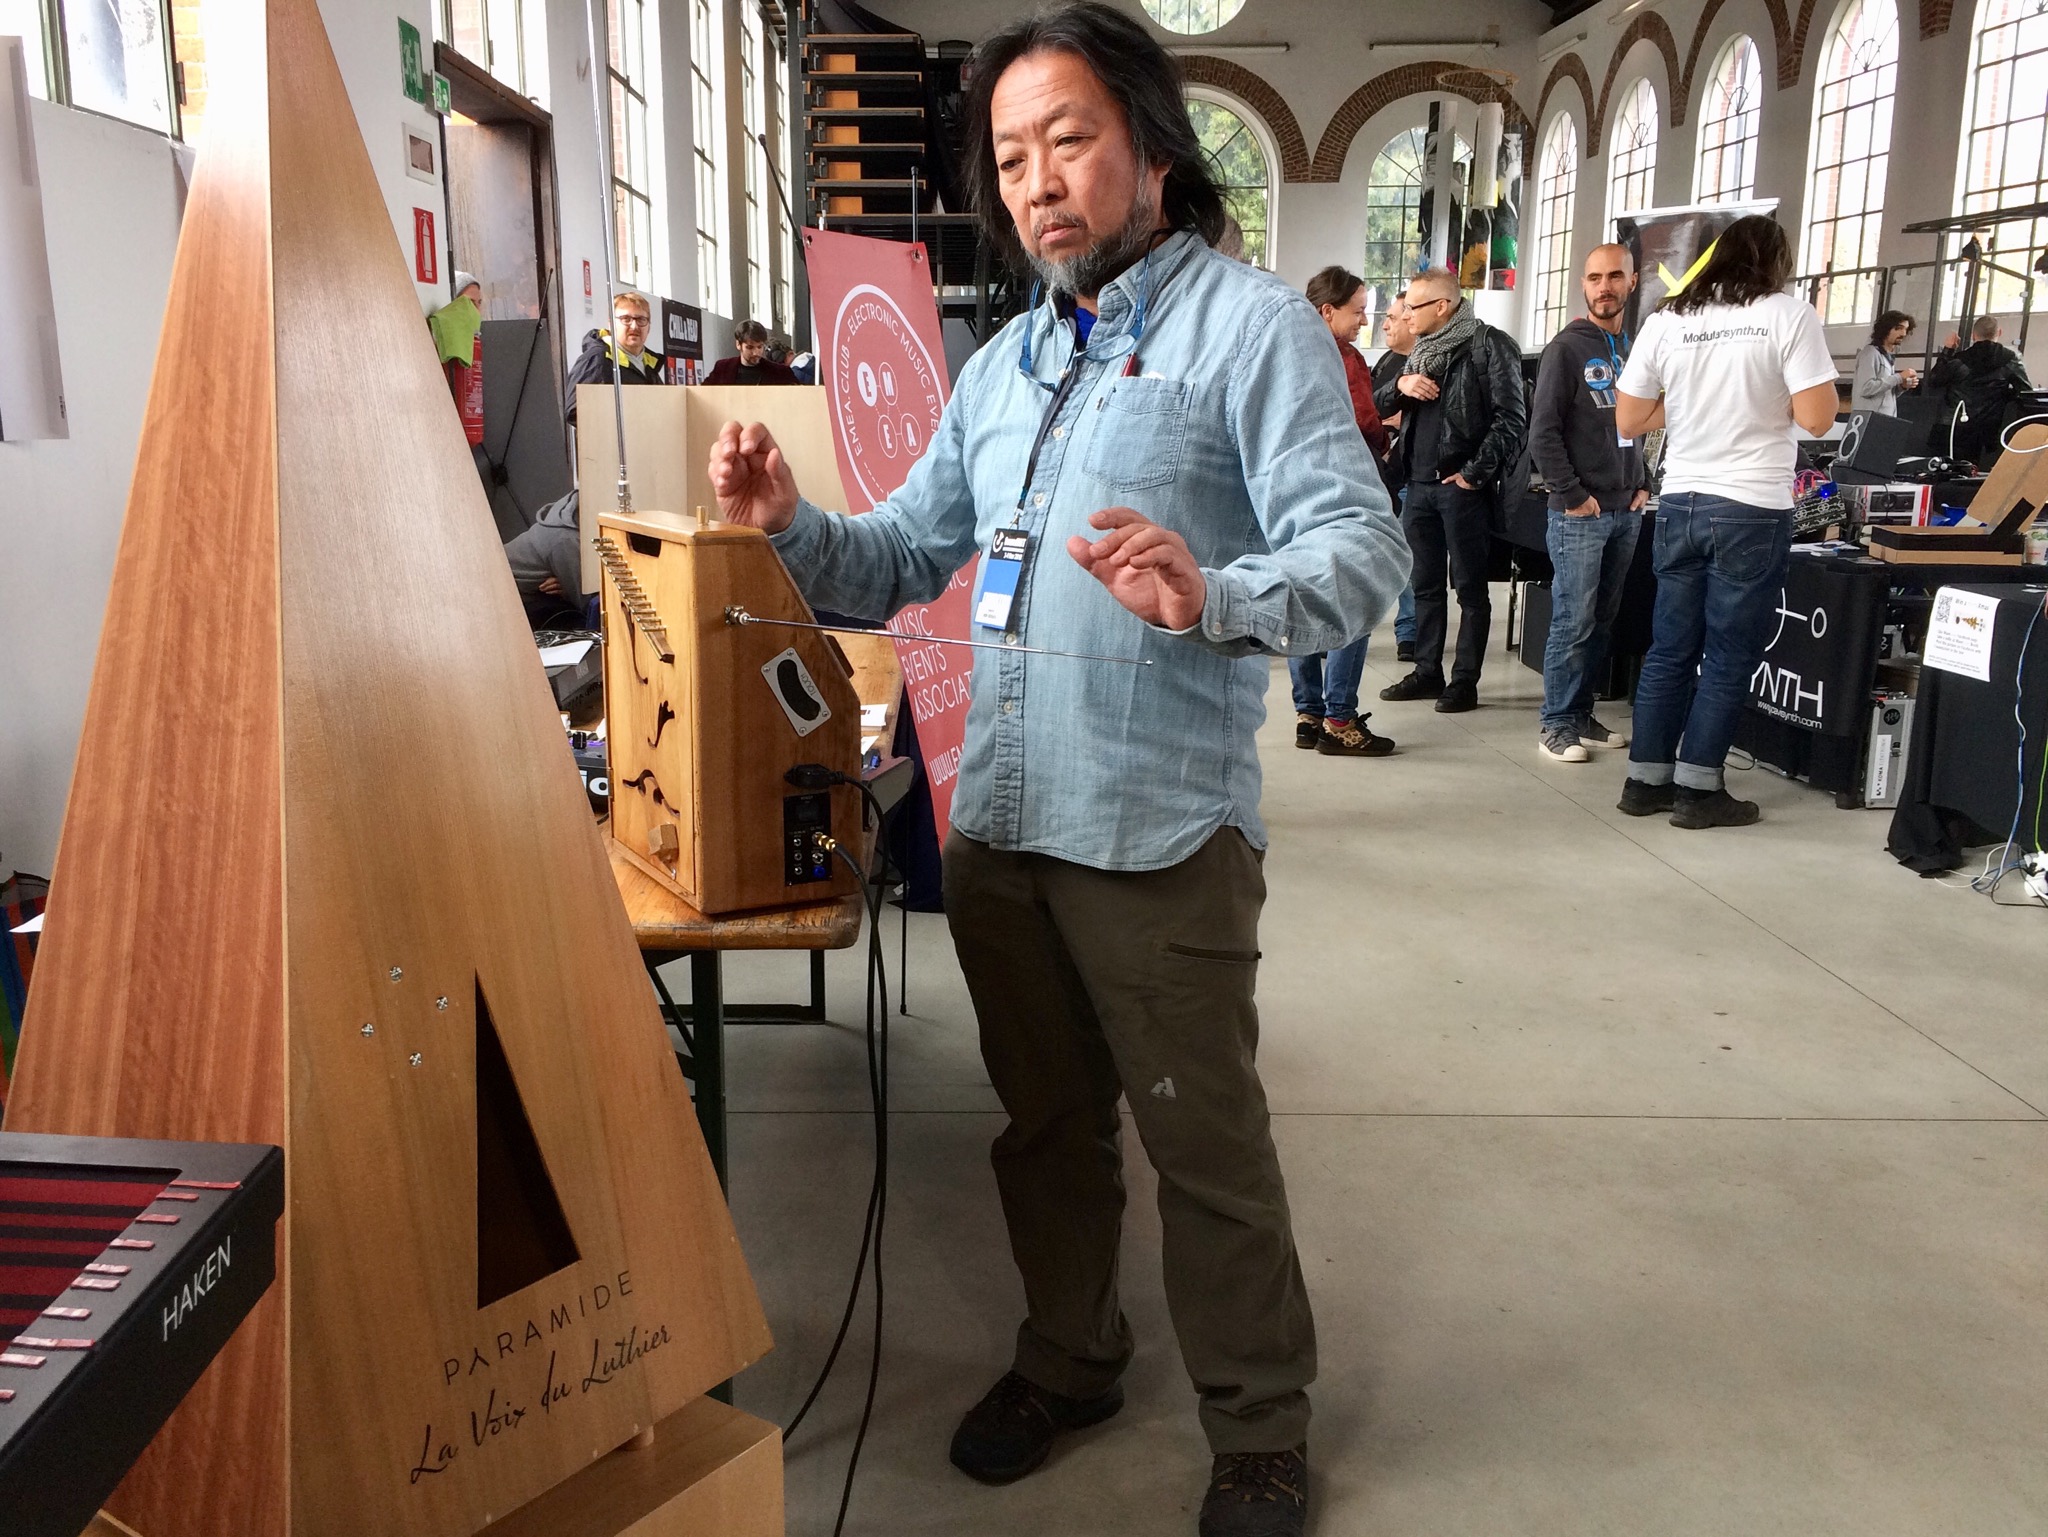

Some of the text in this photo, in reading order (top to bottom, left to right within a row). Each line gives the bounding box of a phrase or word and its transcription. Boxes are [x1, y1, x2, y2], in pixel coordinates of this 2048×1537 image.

[847, 302, 899, 336] ELECTRONIC
[900, 332, 931, 389] MUSIC
[926, 394, 939, 433] EVE
[1682, 325, 1769, 344] Modularsynth.ru
[888, 607, 934, 648] MUSIC
[901, 643, 948, 686] EVENTS
[163, 1234, 231, 1342] HAKEN
[410, 1324, 672, 1485] La Voix du Luthier
